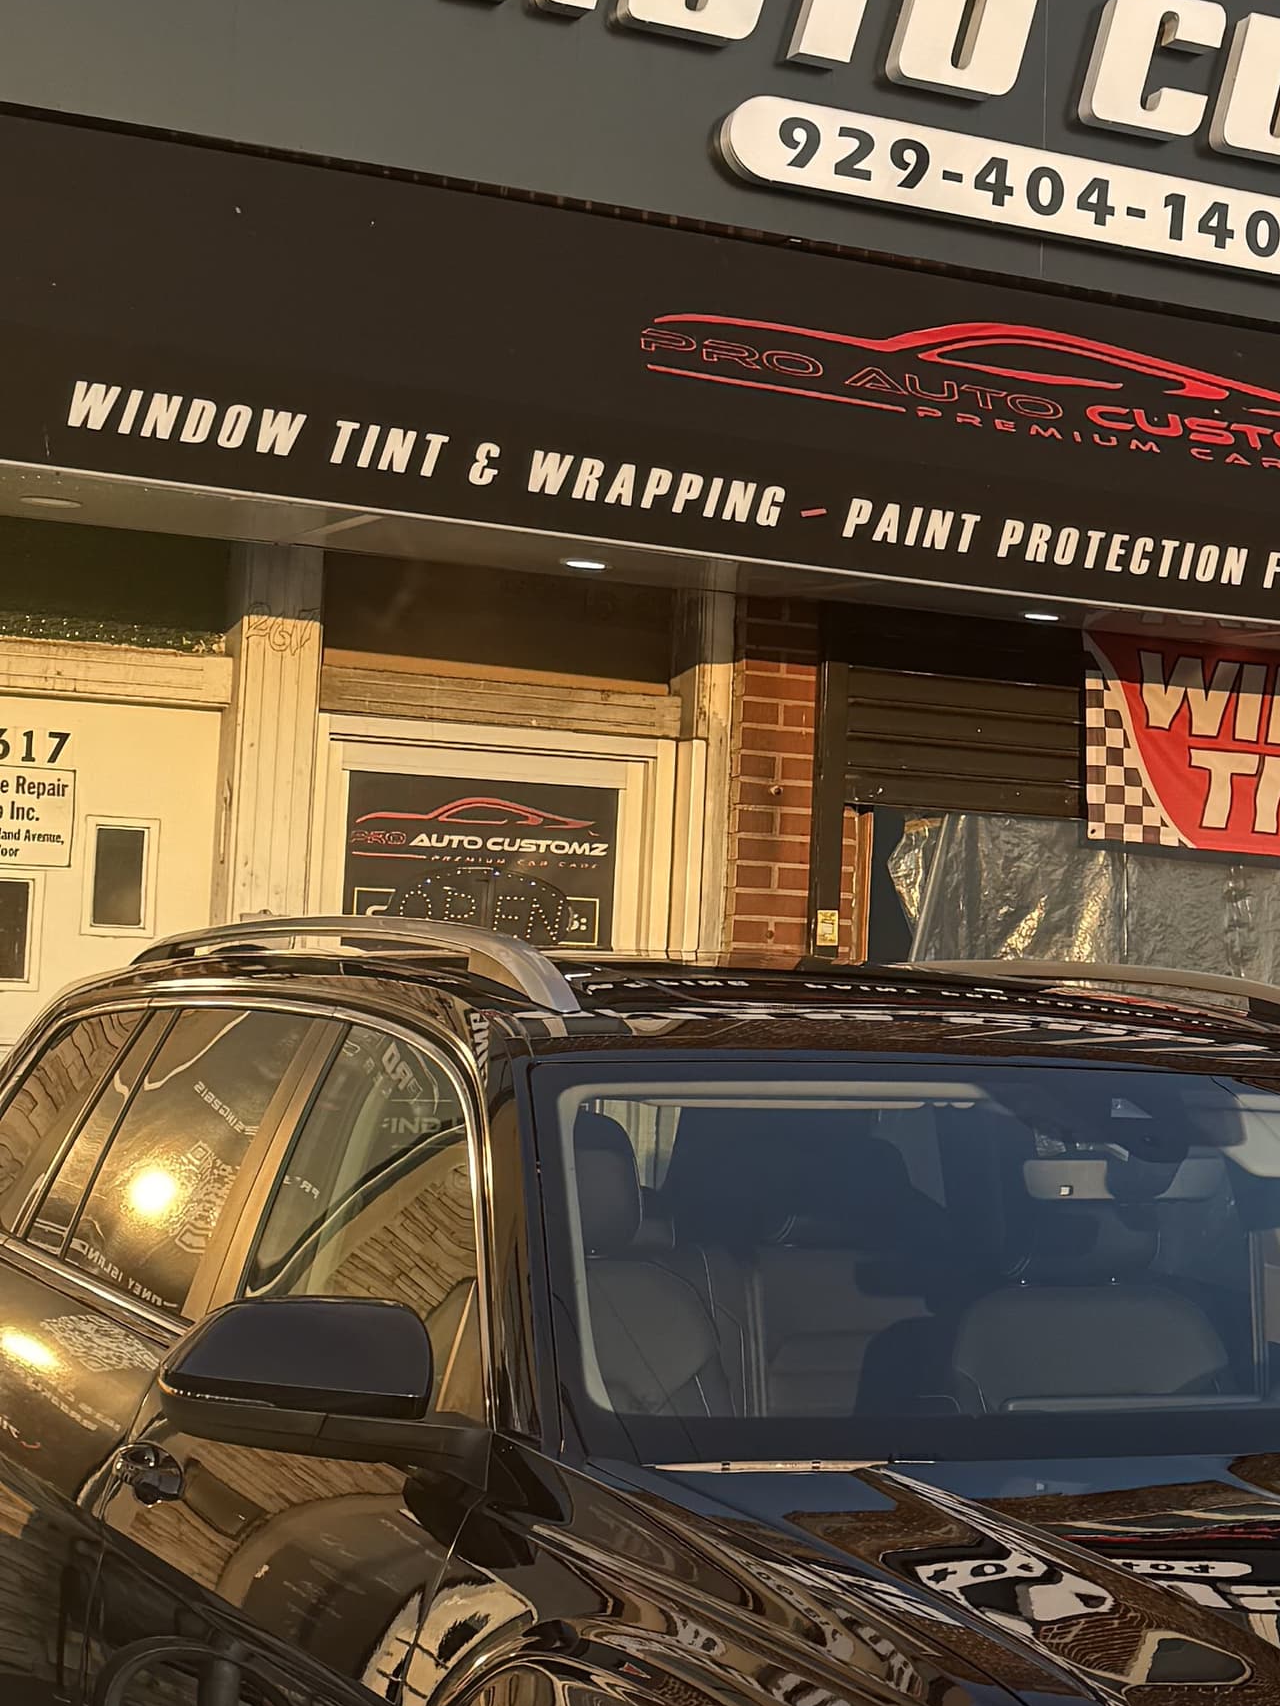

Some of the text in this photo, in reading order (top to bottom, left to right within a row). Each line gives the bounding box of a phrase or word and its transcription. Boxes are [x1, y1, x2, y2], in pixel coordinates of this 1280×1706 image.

[641, 327, 824, 378] PRO
[844, 366, 1064, 419] AUTO
[915, 405, 1160, 453] PREMIUM
[67, 380, 307, 458] WINDOW
[329, 419, 449, 479] TINT
[468, 441, 499, 486] &
[527, 449, 786, 528] WRAPPING
[841, 497, 981, 555] PAINT
[997, 519, 1245, 586] PROTECTION
[15, 775, 69, 804] Repair
[9, 805, 41, 828] Inc.
[23, 829, 65, 853] Avenue,
[409, 833, 483, 849] AUTO
[486, 837, 609, 857] CUSTOMZ
